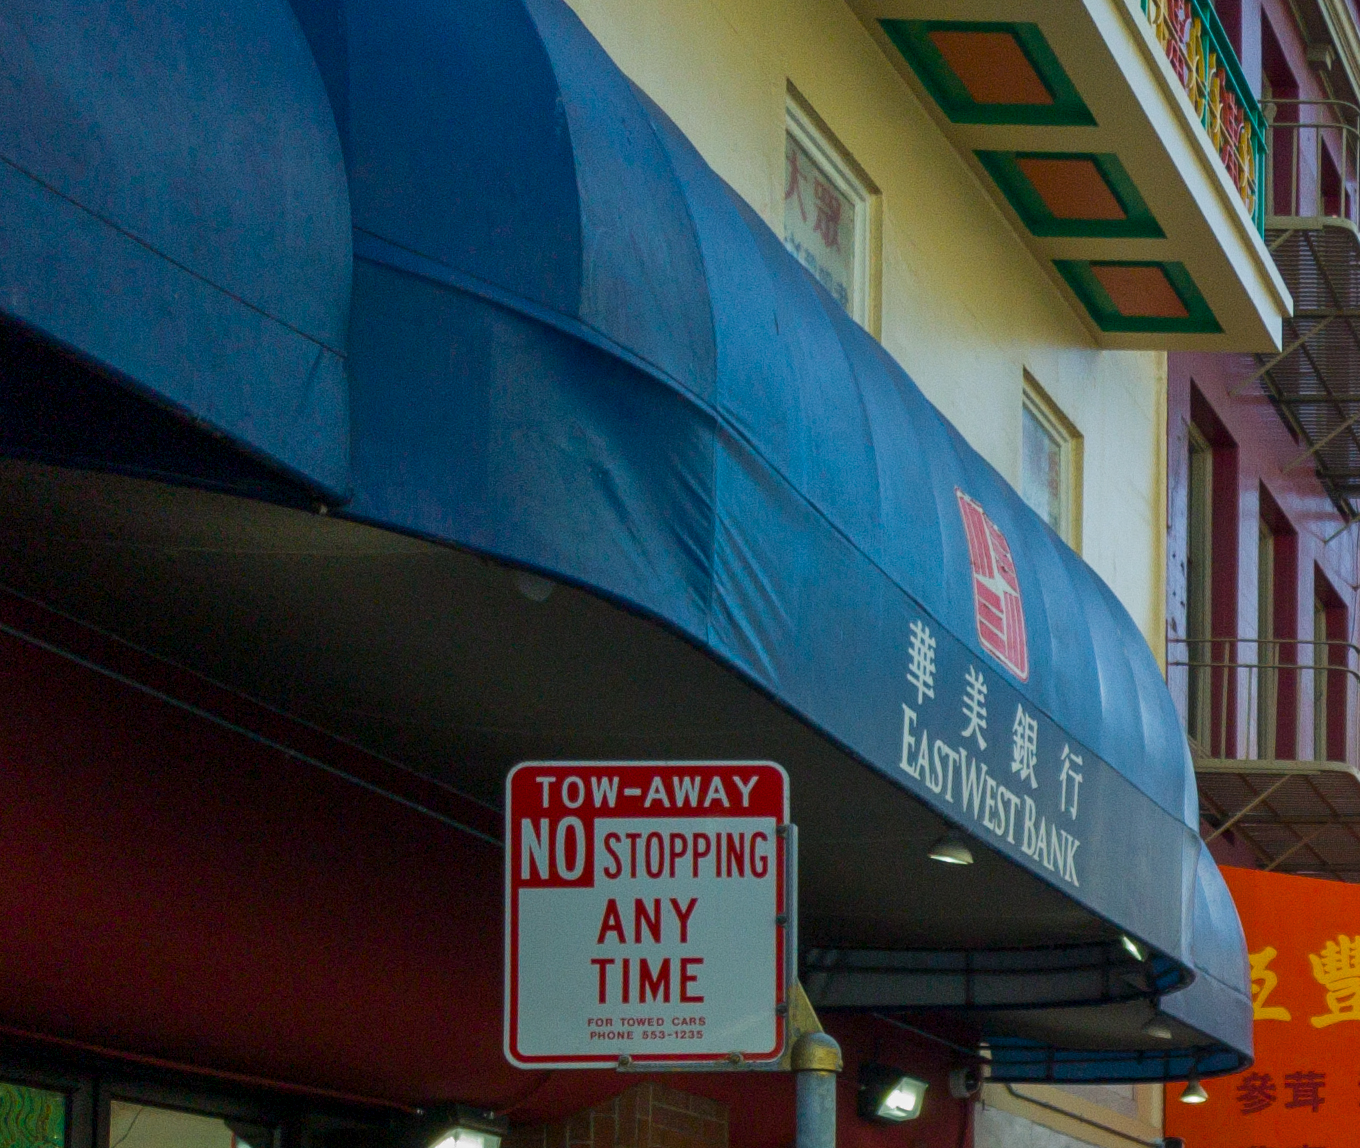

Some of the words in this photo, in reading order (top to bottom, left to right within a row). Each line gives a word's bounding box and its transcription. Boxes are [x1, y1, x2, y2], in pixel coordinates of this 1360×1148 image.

[906, 620, 1084, 821] 華美銀行
[535, 776, 759, 809] TOW-AWAY
[520, 816, 586, 881] NO
[602, 831, 769, 880] STOPPING
[1021, 793, 1080, 888] BANK
[596, 898, 699, 944] ANY
[590, 957, 705, 1005] TIME
[587, 1018, 613, 1028] FOR
[619, 1017, 665, 1028] TOWED
[671, 1016, 707, 1027] CARS
[589, 1030, 634, 1041] PHONE
[641, 1029, 704, 1040] 553-1235
